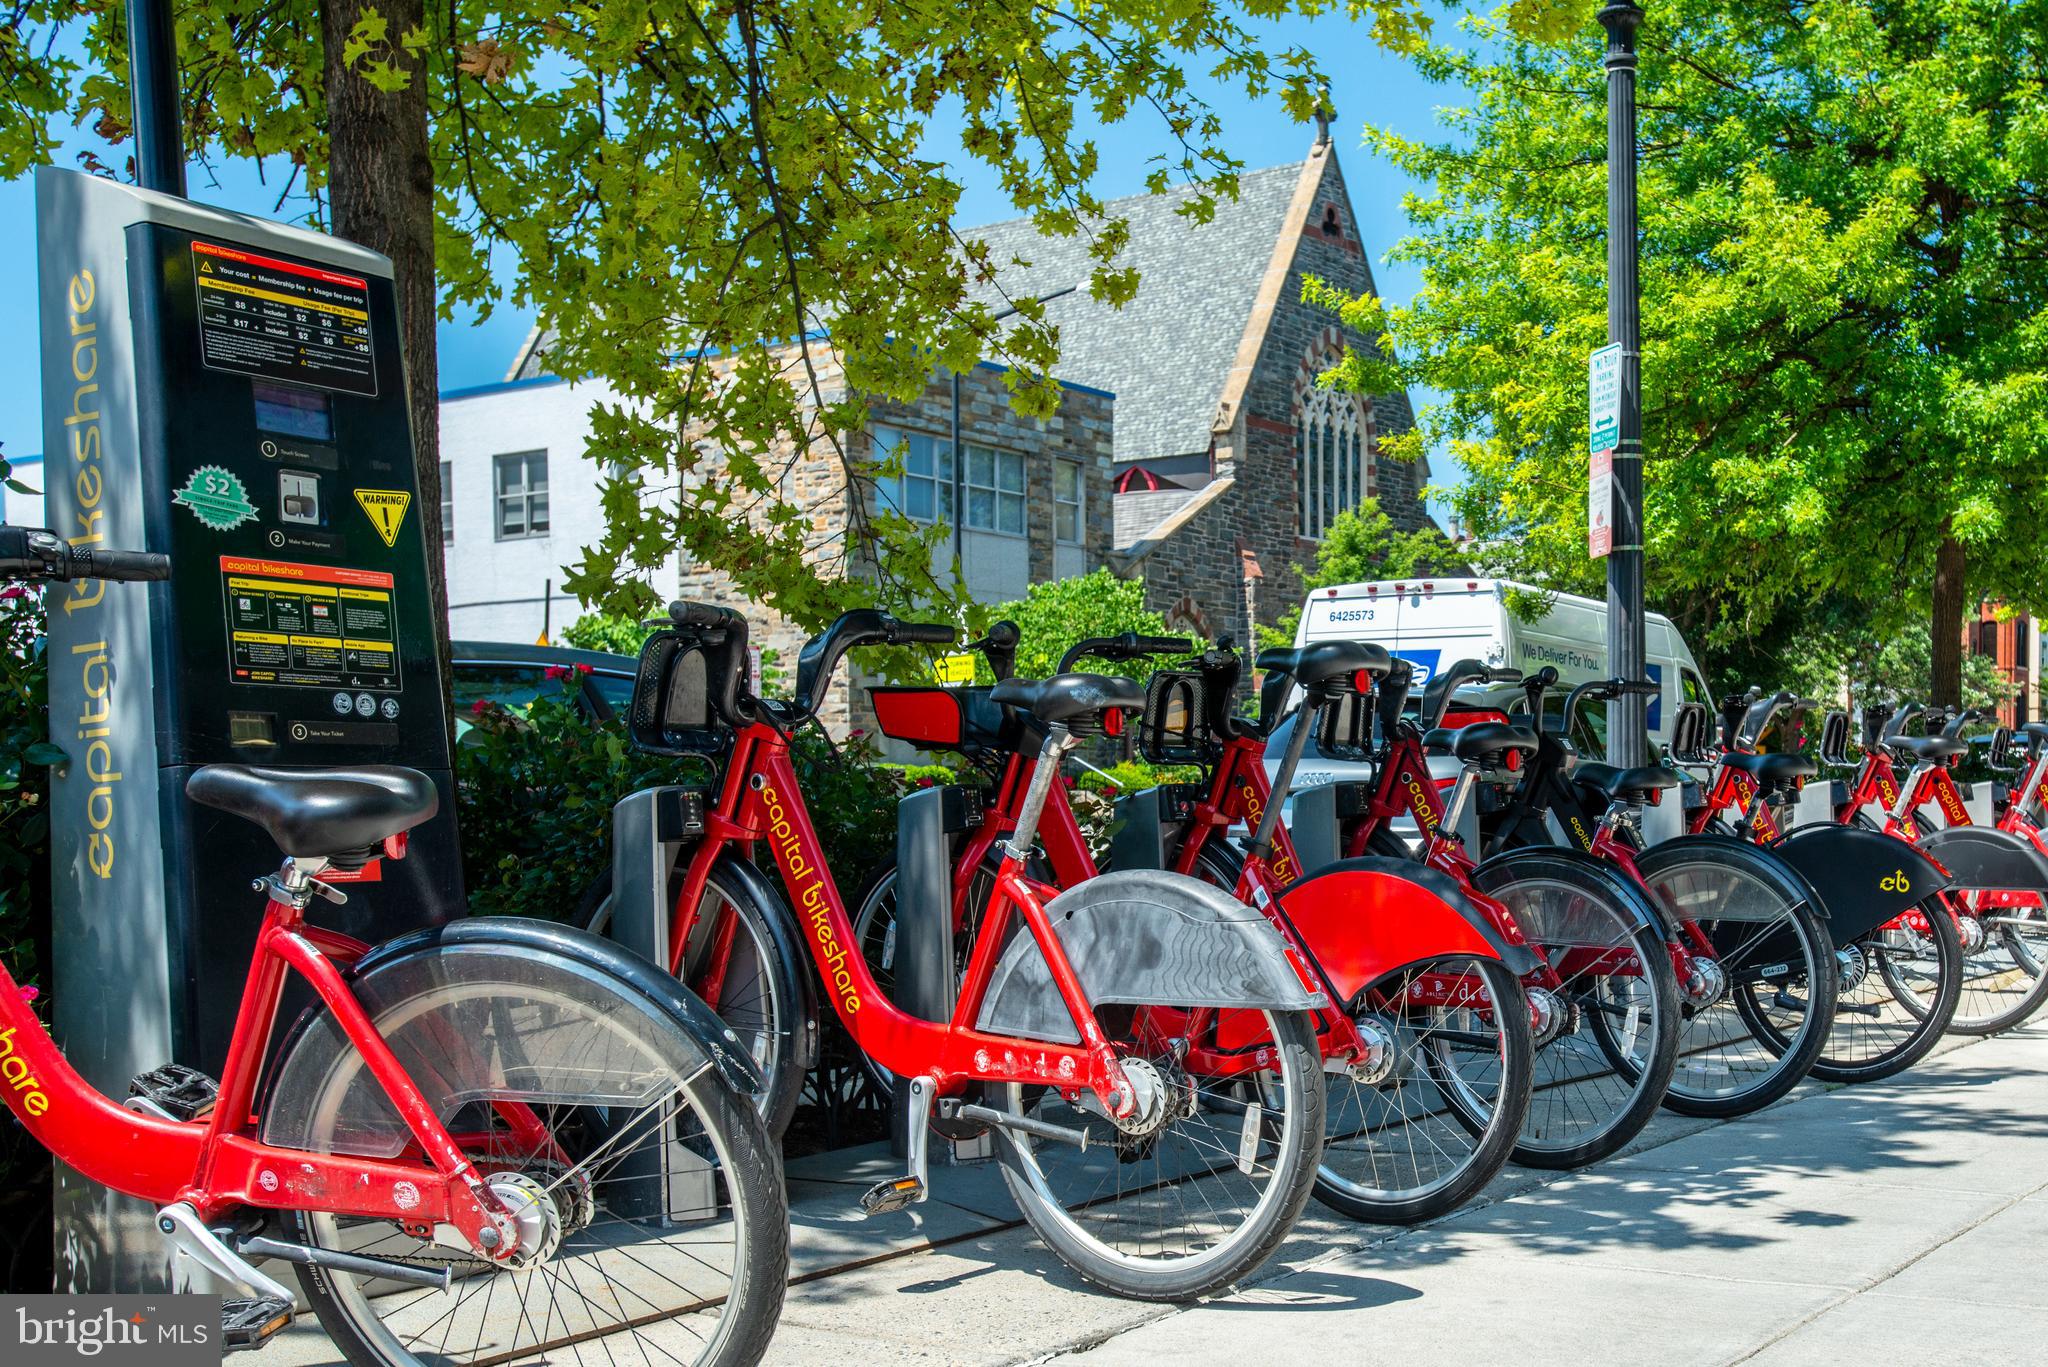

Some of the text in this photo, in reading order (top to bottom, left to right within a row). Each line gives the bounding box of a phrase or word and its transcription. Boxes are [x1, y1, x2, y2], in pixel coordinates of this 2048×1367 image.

[207, 279, 255, 295] Membership Fee
[219, 265, 234, 276] Your
[235, 269, 250, 279] cost
[258, 274, 294, 289] Membership
[295, 283, 305, 291] fee
[313, 287, 332, 298] Usage
[333, 291, 342, 299] fee
[342, 294, 352, 302] per
[352, 295, 363, 304] trip
[234, 300, 246, 310] $8
[302, 300, 319, 309] Usage
[320, 303, 331, 311] Fee
[263, 307, 287, 318] Included
[296, 313, 307, 323] $2
[233, 318, 249, 329] $17
[321, 318, 331, 328] $6
[264, 326, 288, 337] Included
[298, 331, 308, 341] $2
[322, 336, 333, 345] $6
[63, 267, 104, 618] bkeshare
[205, 474, 230, 496] $2
[312, 541, 331, 549] Payment
[226, 559, 303, 576] capital bikeshare
[1329, 609, 1375, 622] 6425573
[1522, 643, 1600, 671] We Deliver For You.
[72, 641, 121, 880] capital
[1938, 782, 1966, 821] capital
[762, 787, 861, 1014] capital bikeshare
[0, 1025, 49, 1117] hare
